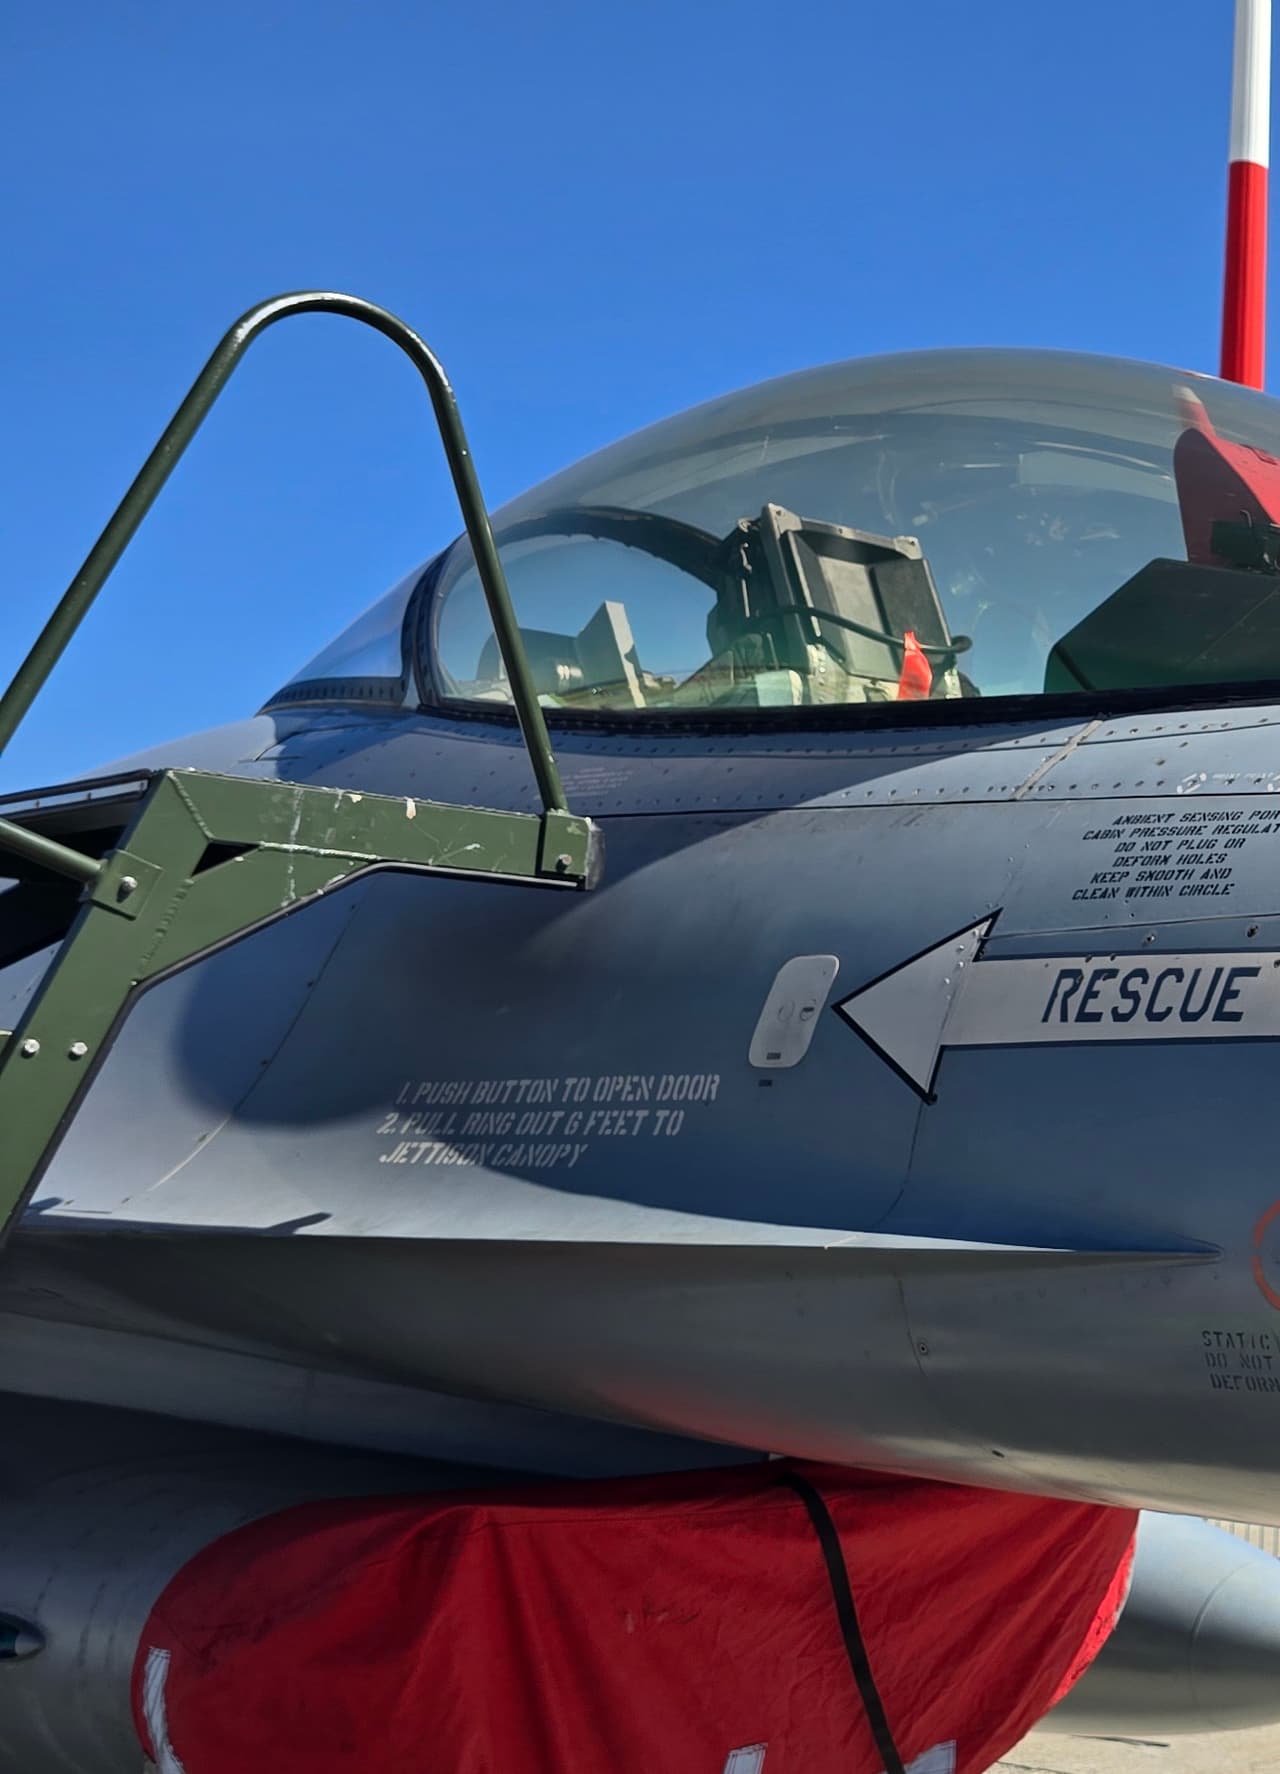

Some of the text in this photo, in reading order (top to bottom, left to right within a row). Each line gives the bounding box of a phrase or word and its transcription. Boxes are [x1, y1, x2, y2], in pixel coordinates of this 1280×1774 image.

[1112, 813, 1176, 825] AMBIENT
[1179, 811, 1244, 822] SENSING
[1082, 828, 1126, 840] CABIN
[1129, 825, 1208, 838] PRESSURE
[1114, 838, 1246, 852] DO NOT PLUG OR
[1112, 853, 1228, 868] DEFORM HOLES
[1090, 868, 1233, 884] KEEP SMOOTH AND
[1072, 883, 1235, 901] CLEAN WITHIN CIRCLE
[1041, 966, 1262, 1023] RESCUE
[412, 1080, 474, 1104] PUSH
[471, 1078, 560, 1104] BUTTON
[560, 1076, 592, 1102] TO
[593, 1075, 656, 1101] OPEN
[655, 1073, 720, 1101] DOOR
[400, 1111, 457, 1136] PULL
[460, 1111, 516, 1136] RING
[515, 1110, 566, 1136] OUT
[583, 1110, 650, 1136] FEET
[652, 1109, 686, 1136] TO
[379, 1141, 590, 1168] JETTISON CANOPY
[1201, 1331, 1270, 1350] STATIC
[1204, 1352, 1228, 1368] DO
[1240, 1354, 1273, 1371] NOT
